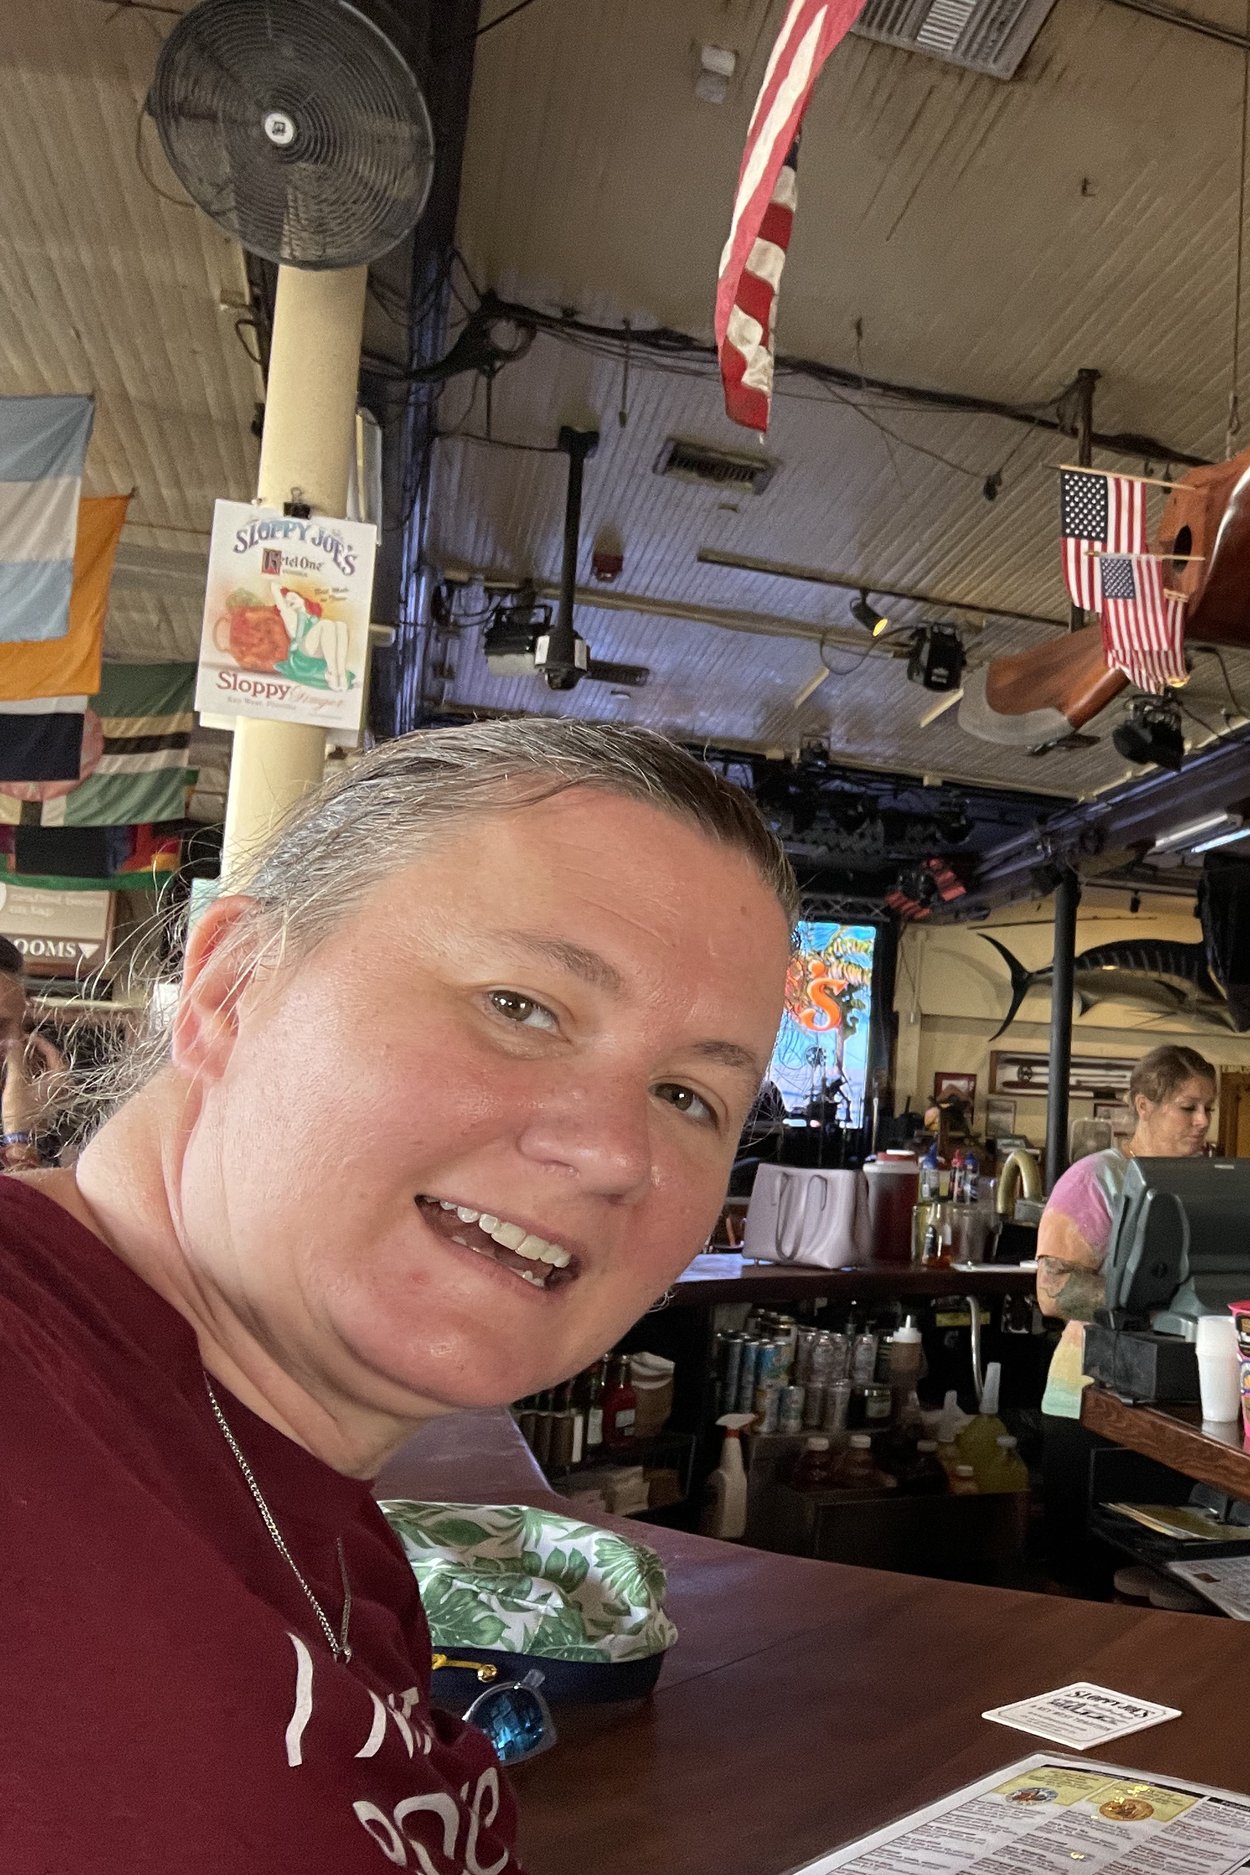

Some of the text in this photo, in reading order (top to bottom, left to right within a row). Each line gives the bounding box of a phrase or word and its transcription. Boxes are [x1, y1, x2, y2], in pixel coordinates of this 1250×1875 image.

[233, 519, 359, 577] SLOPPY JOE'S
[216, 670, 292, 701] Sloppy
